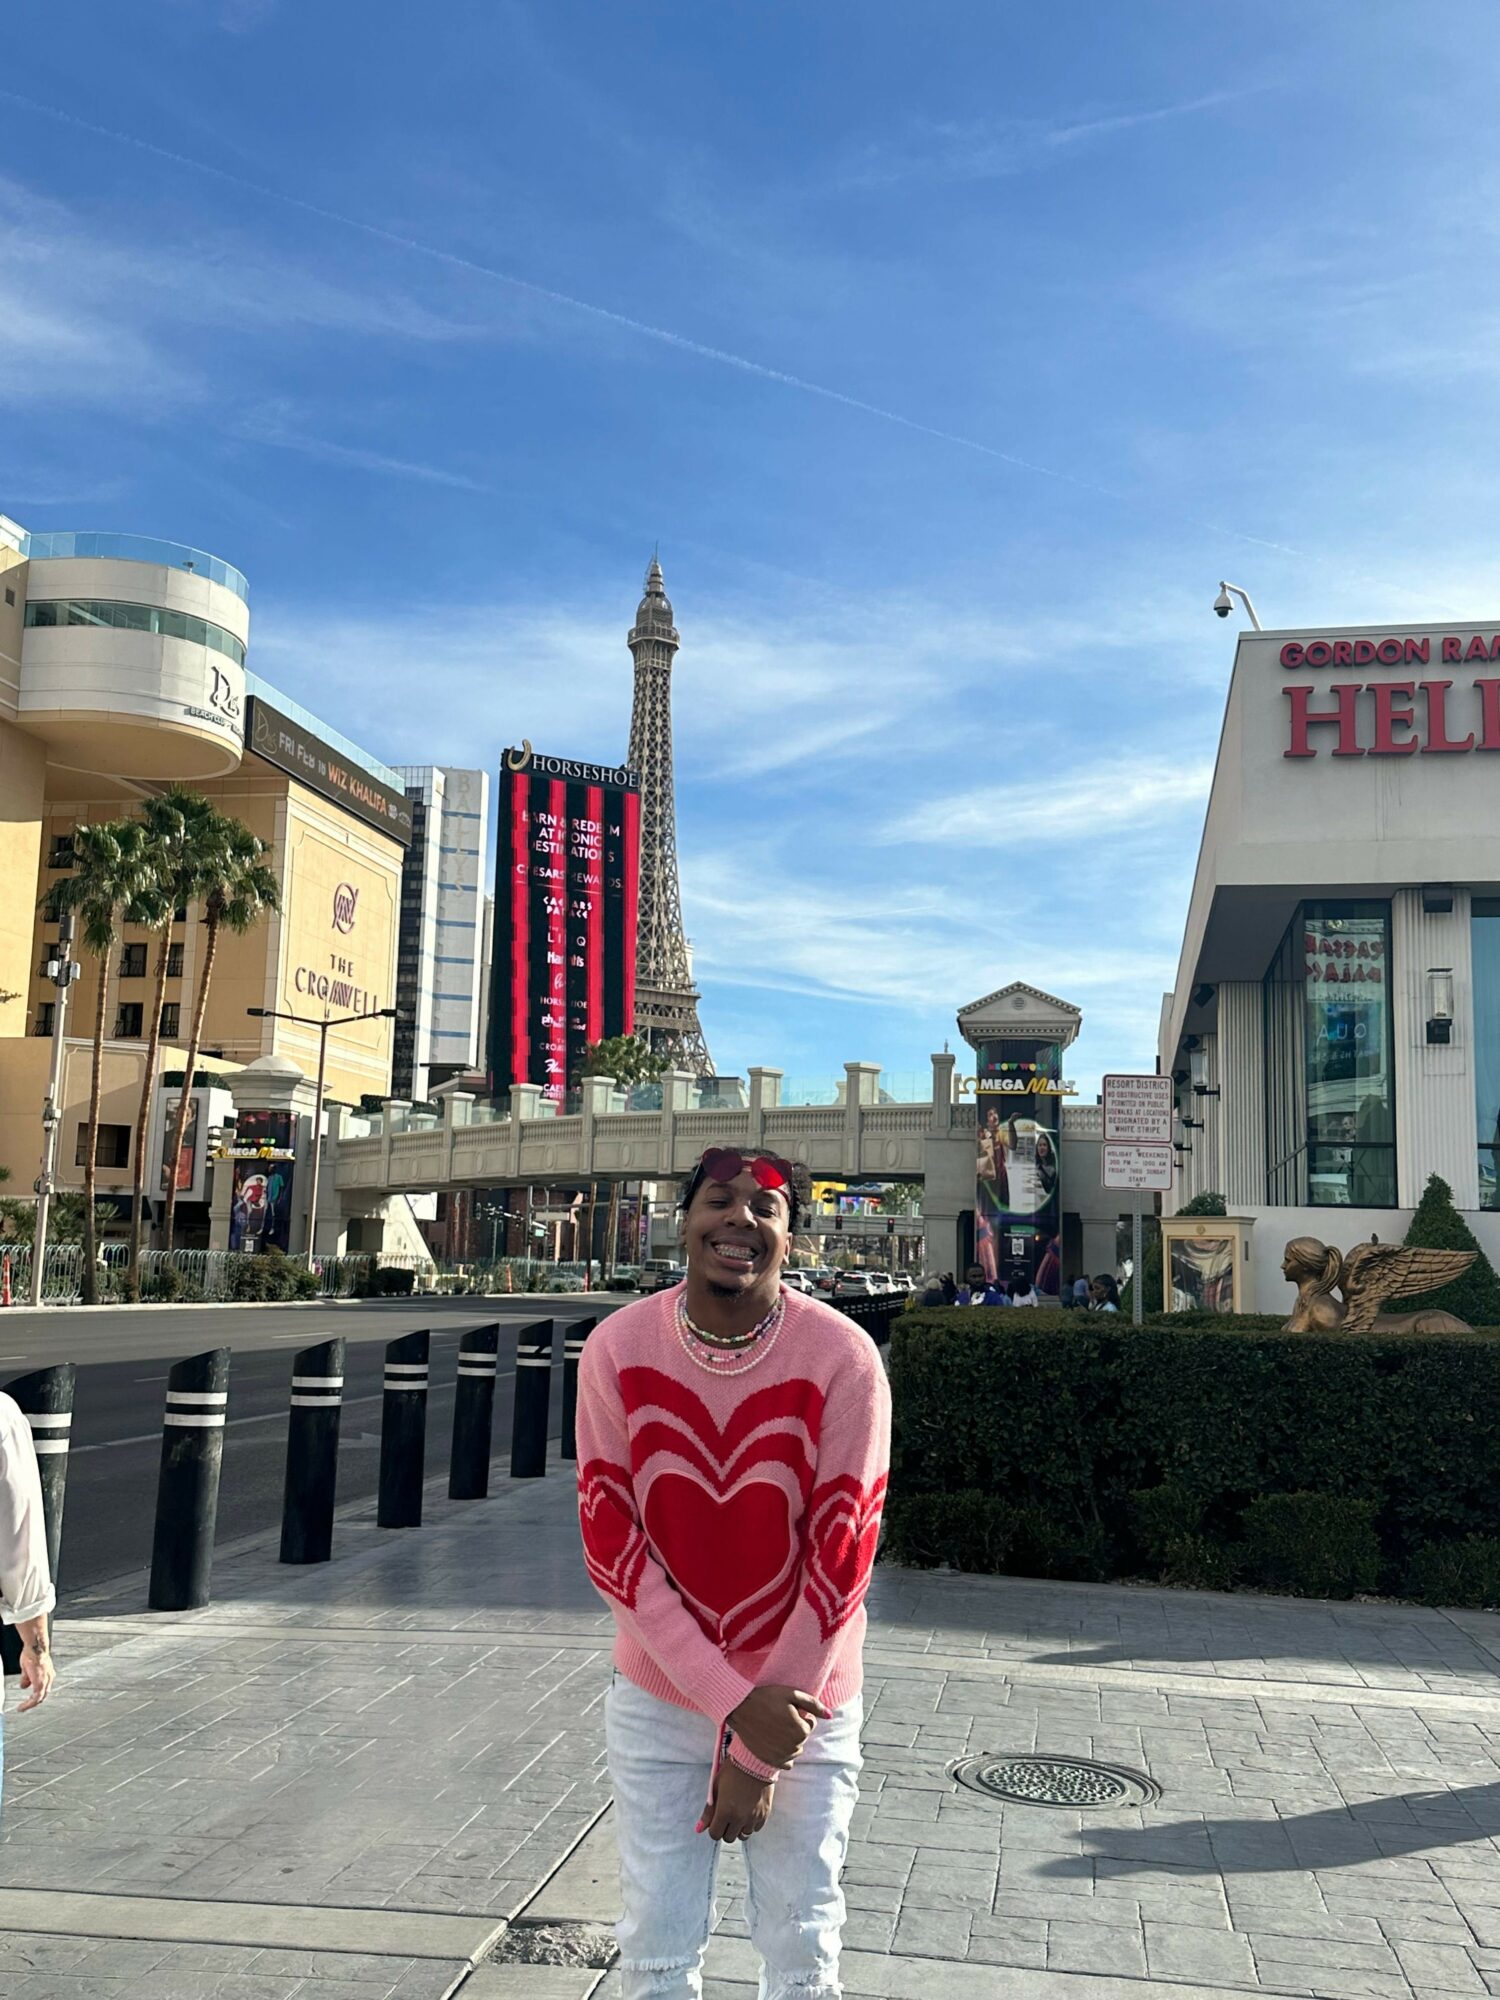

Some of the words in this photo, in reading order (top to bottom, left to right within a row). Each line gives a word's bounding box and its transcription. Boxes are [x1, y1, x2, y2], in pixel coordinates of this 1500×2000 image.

[1280, 638, 1430, 669] GORDON
[279, 731, 295, 757] FRI
[297, 743, 315, 769] FEB
[328, 761, 348, 791] WIZ
[349, 776, 388, 817] KHALIFA
[532, 755, 639, 788] HORSESHOE
[539, 827, 554, 840] AT
[572, 818, 620, 837] REDEM
[516, 863, 565, 881] CESARS
[572, 872, 622, 889] EWAS
[543, 896, 592, 911] CAEARS
[547, 932, 587, 947] LIQ
[330, 953, 354, 978] THE
[1107, 1080, 1134, 1088] RESORT
[1136, 1080, 1168, 1090] DISTRICT
[1116, 1091, 1152, 1099] OBSTRUCTIVE
[1108, 1116, 1149, 1125] DESIGNATED
[1115, 1125, 1135, 1133] WHITE
[1137, 1126, 1161, 1134] STRIPE
